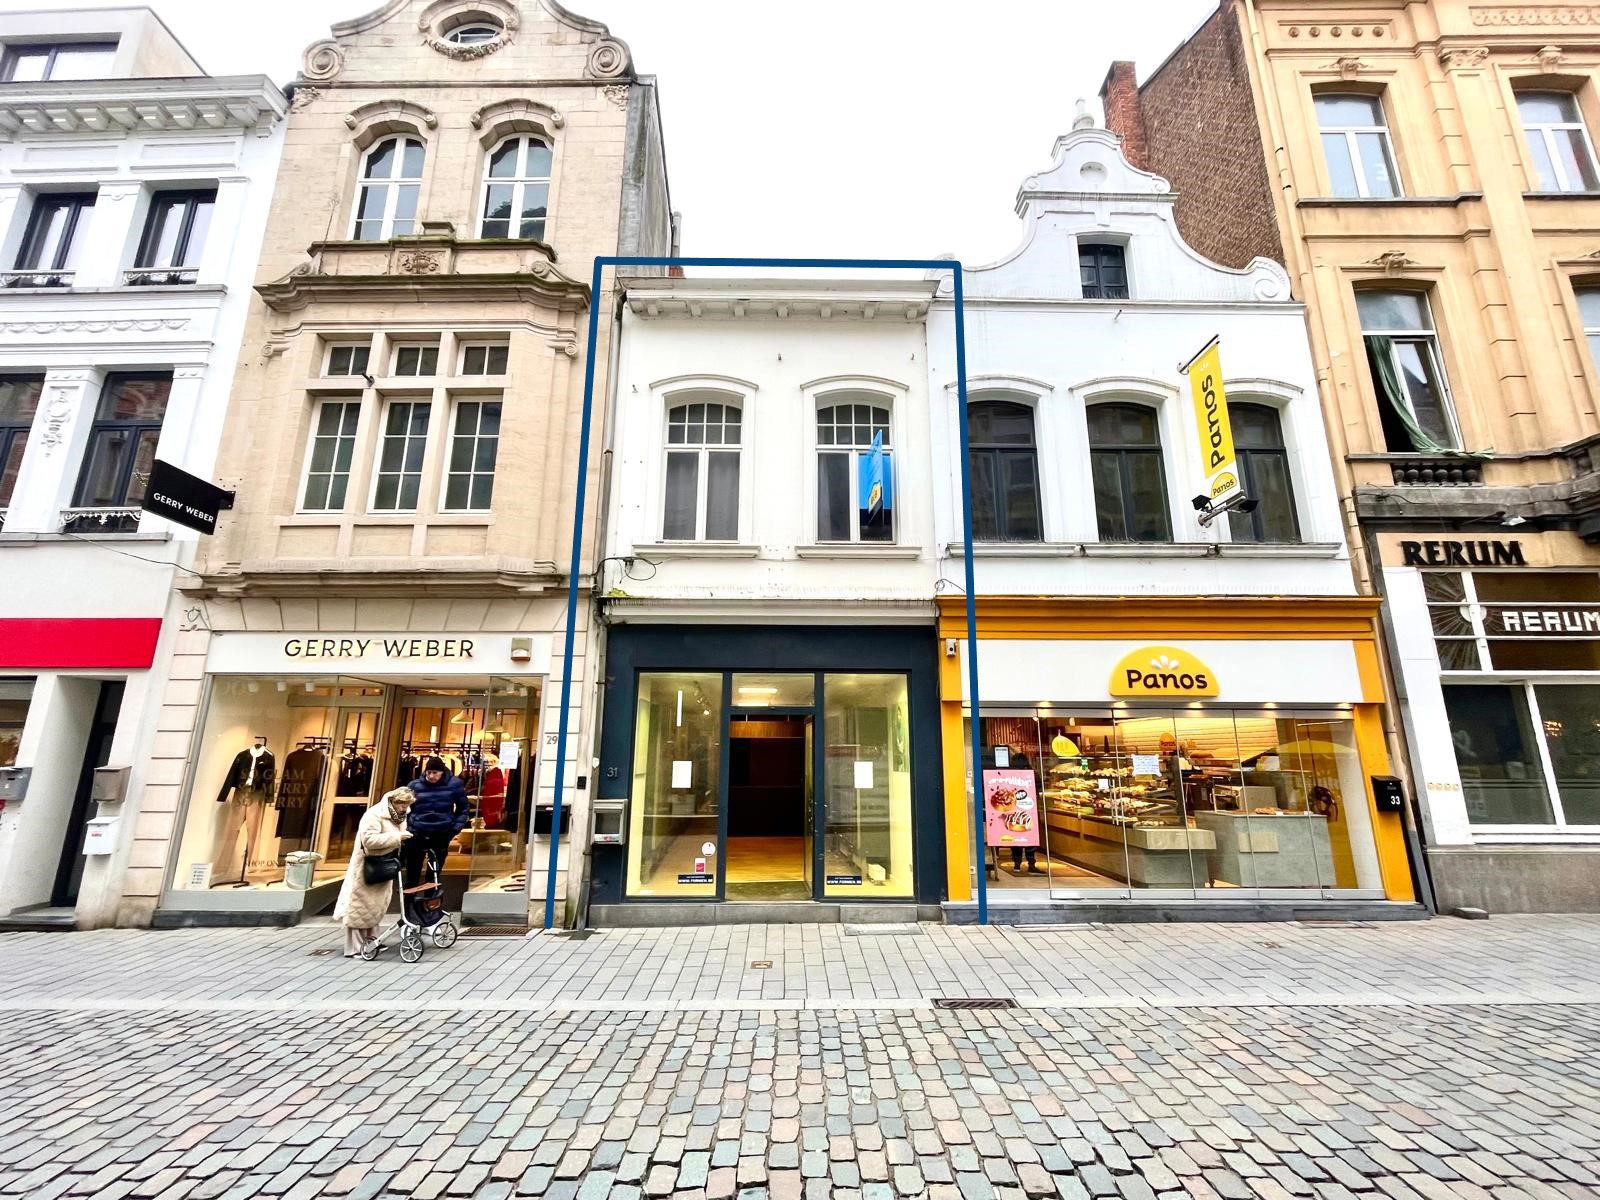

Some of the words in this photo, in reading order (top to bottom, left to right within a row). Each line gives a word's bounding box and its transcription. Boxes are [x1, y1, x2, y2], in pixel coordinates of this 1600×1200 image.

[1201, 374, 1226, 469] Panos
[1212, 478, 1235, 496] Panos
[153, 492, 184, 510] GERRY
[185, 505, 215, 523] WEBER
[1400, 540, 1529, 566] RERUM
[1502, 611, 1600, 632] RERUM
[284, 639, 371, 657] GERRY
[383, 639, 474, 658] WEBER
[1126, 669, 1208, 690] Panos
[546, 735, 558, 745] 29
[606, 766, 618, 777] 31
[258, 796, 306, 808] ERRY
[1390, 795, 1401, 805] 33
